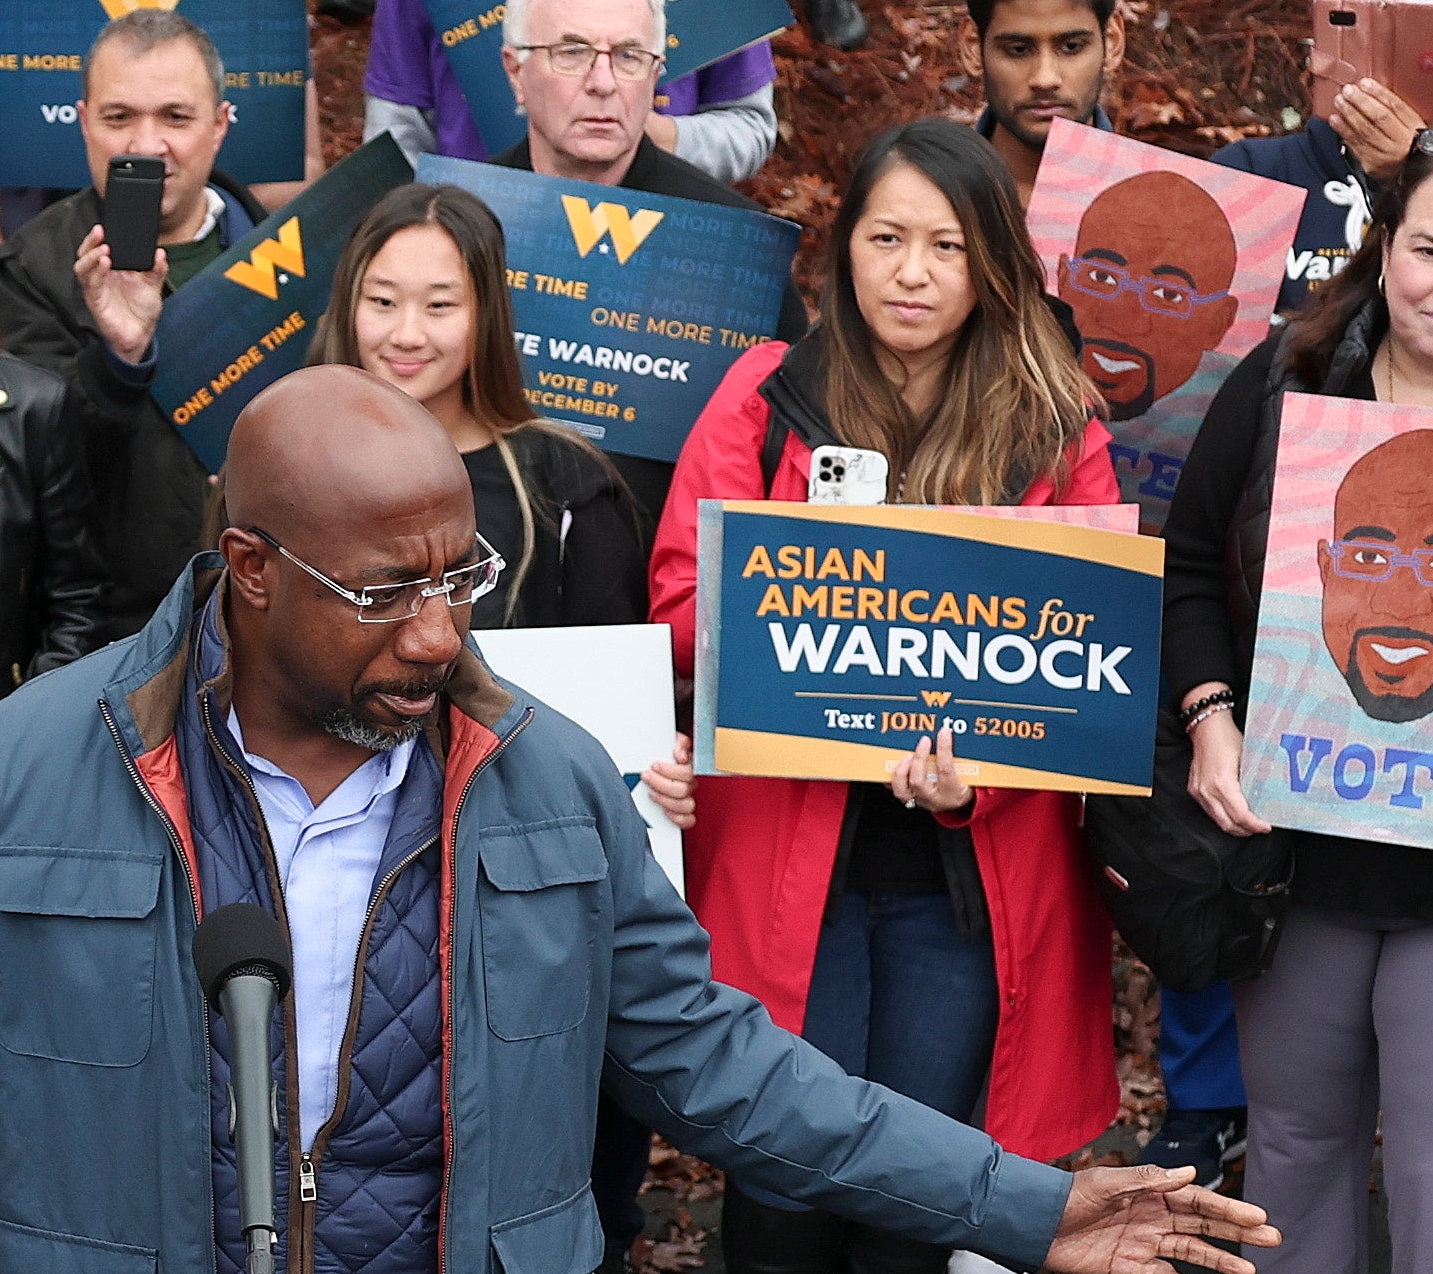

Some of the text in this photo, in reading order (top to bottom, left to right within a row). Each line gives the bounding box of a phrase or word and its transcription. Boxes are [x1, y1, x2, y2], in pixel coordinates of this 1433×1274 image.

[23, 54, 81, 70] MORE
[534, 274, 588, 300] TIME
[591, 307, 712, 344] ONE MORE
[173, 311, 307, 425] ONE MORE TIME
[548, 338, 690, 382] WARNOCK
[539, 371, 618, 398] VOTE BY
[741, 545, 886, 583] ASIAN
[756, 584, 1094, 640] AMERICANS for
[768, 622, 1133, 695] WARNOCK
[824, 709, 1045, 740] Text JOIN 52005
